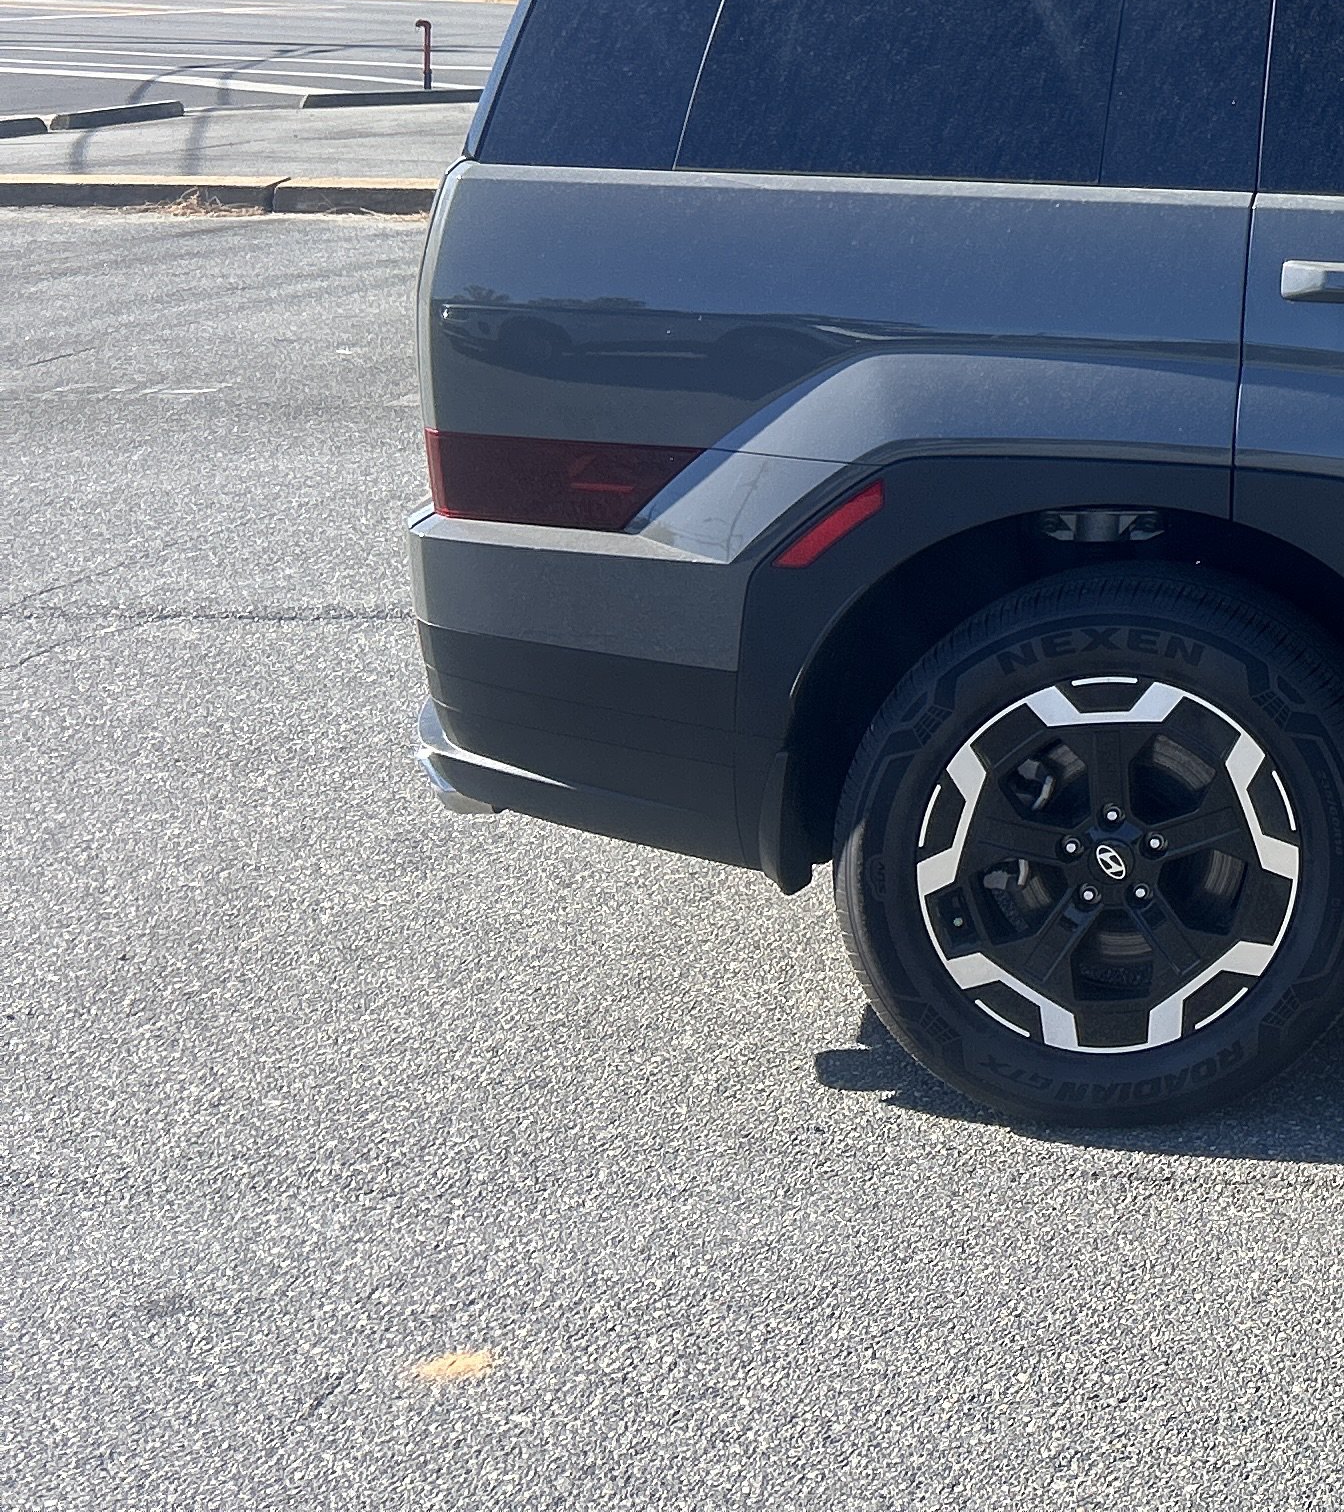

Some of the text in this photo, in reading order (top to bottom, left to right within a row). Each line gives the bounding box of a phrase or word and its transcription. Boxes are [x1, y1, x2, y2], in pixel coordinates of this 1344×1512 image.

[997, 626, 1206, 675] NEXEN
[977, 1040, 1247, 1105] ROADIAN GTX
